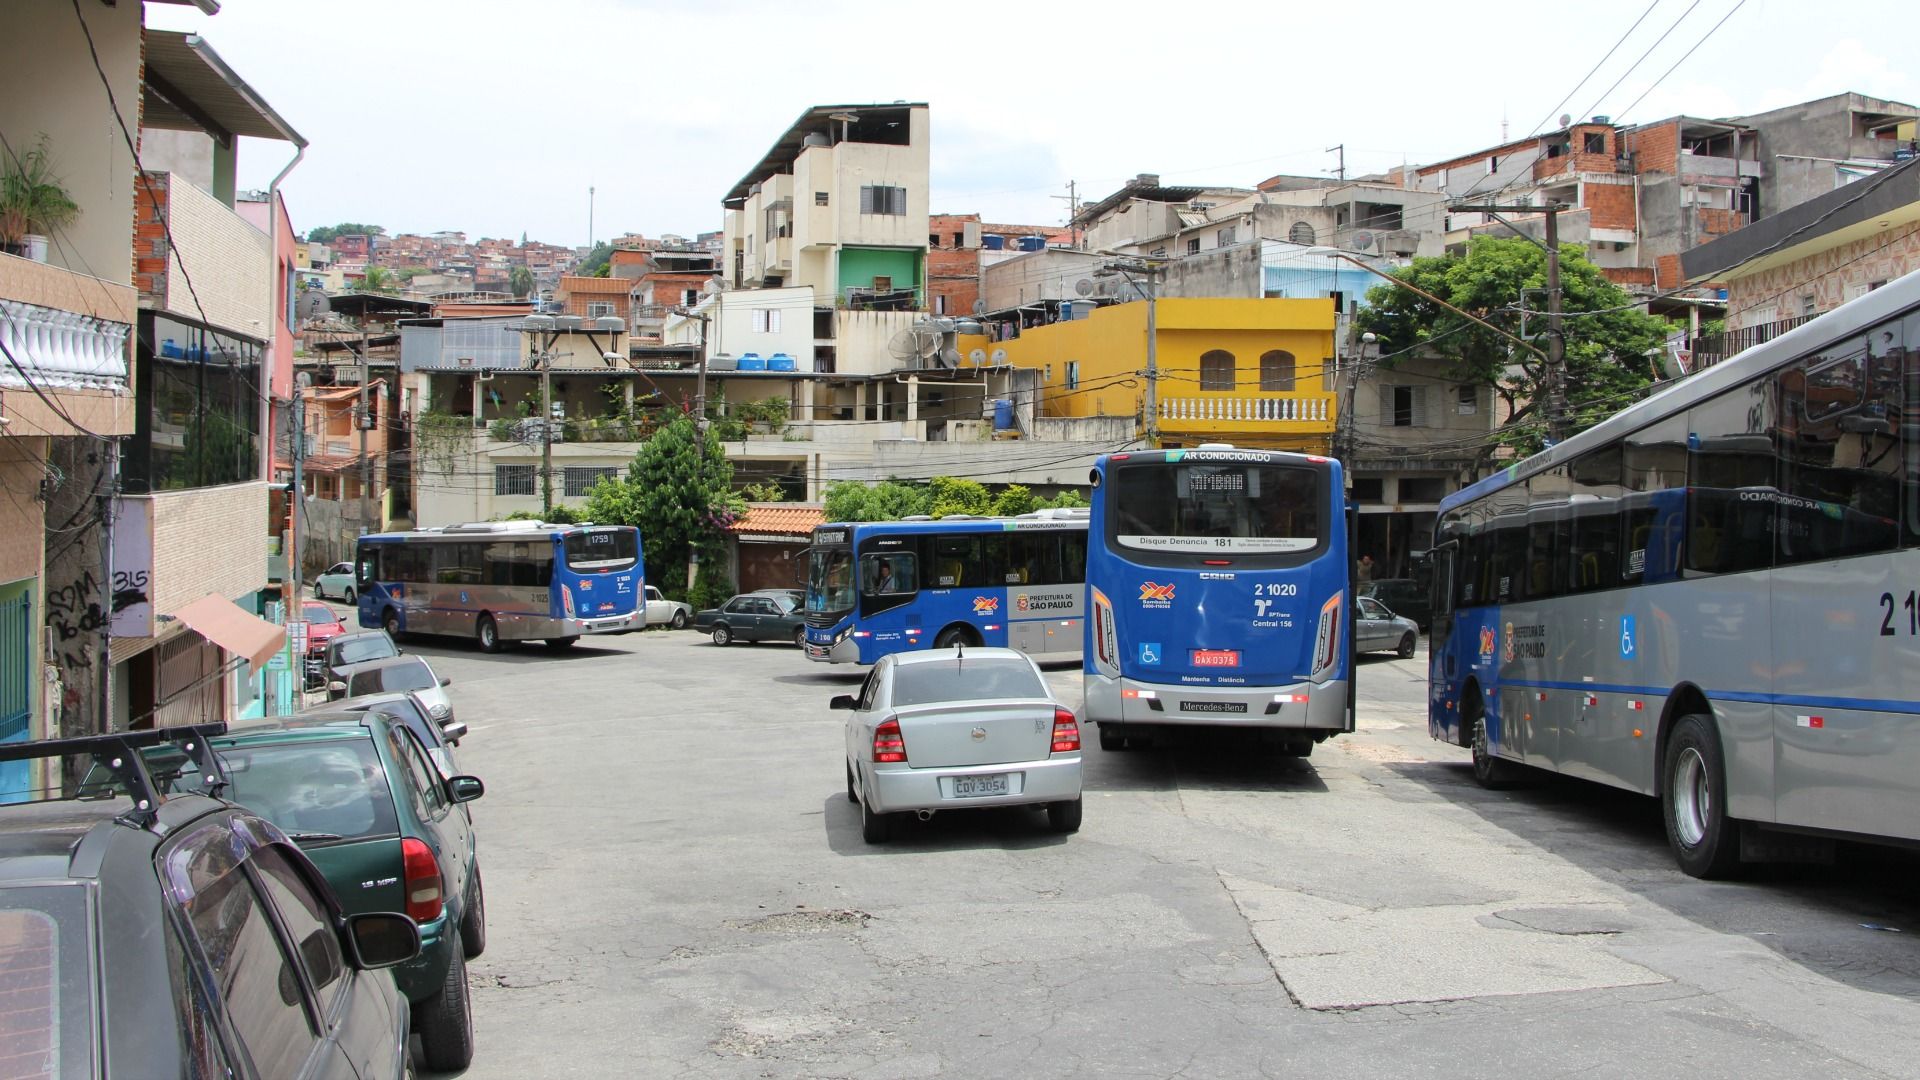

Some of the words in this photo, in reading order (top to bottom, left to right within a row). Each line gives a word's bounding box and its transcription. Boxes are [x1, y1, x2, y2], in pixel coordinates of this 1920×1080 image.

[1184, 452, 1197, 460] AR
[1200, 452, 1271, 462] CONDICIONADO
[591, 534, 609, 544] 1759
[1140, 537, 1167, 547] Disque
[1170, 537, 1208, 545] Denúncia
[1214, 539, 1232, 547] 181
[1254, 583, 1263, 596] 2
[1266, 583, 1297, 596] 1020
[1030, 593, 1065, 601] PREFEITURA
[1030, 601, 1047, 610] SÃO
[1048, 600, 1074, 609] PAULO
[1880, 592, 1896, 636] 2
[1904, 590, 1920, 636] 1
[1252, 619, 1278, 627] Central
[1279, 620, 1293, 628] 156
[1525, 641, 1545, 659] PAULO
[1183, 702, 1245, 712] Mercedes-Benz
